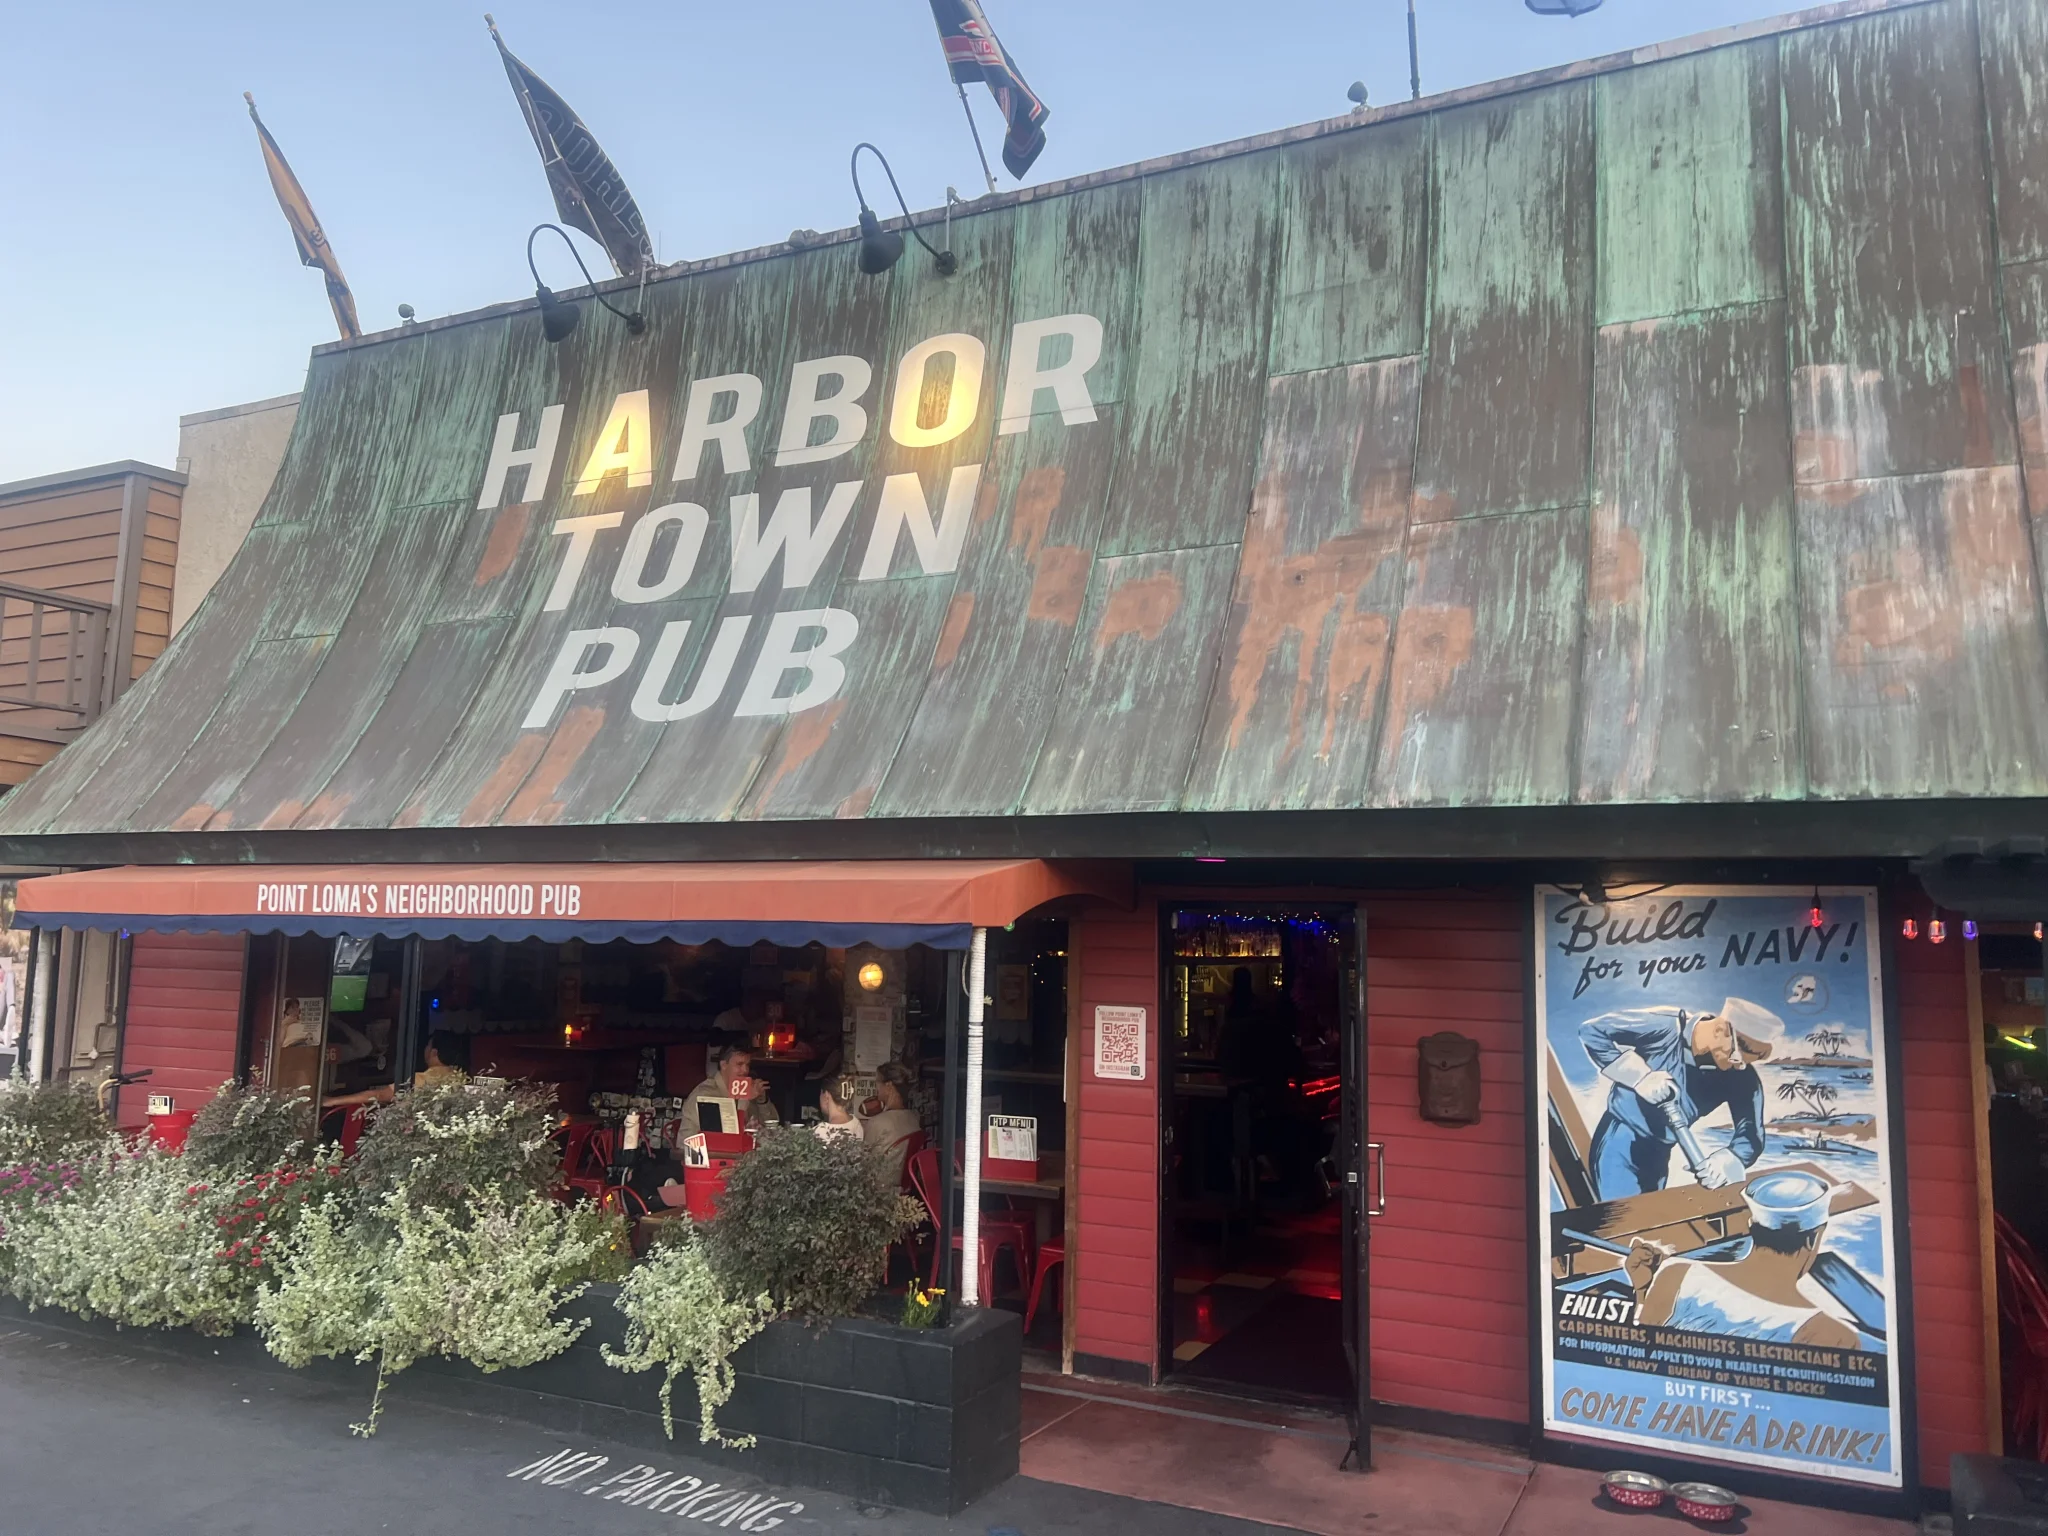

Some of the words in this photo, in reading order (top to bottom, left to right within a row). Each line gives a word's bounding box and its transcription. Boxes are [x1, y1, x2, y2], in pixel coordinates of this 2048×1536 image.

[477, 313, 1103, 509] HARBOR
[543, 463, 981, 612] TOWN
[521, 606, 859, 728] PUB
[257, 884, 308, 912] POINT
[312, 884, 378, 913] LOMA'S
[385, 884, 533, 914] NEIGHBORHOOD
[540, 884, 581, 915] PUB
[1554, 898, 1718, 957] Build
[1572, 955, 1623, 1000] for
[1638, 952, 1707, 988] your
[1719, 921, 1858, 968] NAVY!
[731, 1080, 748, 1095] 82
[857, 1080, 868, 1088] HOT
[857, 1088, 871, 1096] COLD
[993, 1117, 1007, 1128] HTP
[1009, 1118, 1031, 1129] MENU
[1559, 1293, 1644, 1326] ENLIST!
[1558, 1319, 1651, 1345] CARPENTERS,
[1655, 1331, 1741, 1356] MACHINISTS,
[1744, 1342, 1841, 1369] ELECTRICIANS
[1848, 1355, 1878, 1373] ETC.
[1559, 1336, 1578, 1349] FOR
[1580, 1339, 1646, 1358] INFORMATION
[1696, 1356, 1722, 1369] YOUR
[1726, 1359, 1771, 1376] NEAREST
[1604, 1356, 1623, 1368] U.S.
[1627, 1359, 1659, 1372] NAVY
[1668, 1365, 1711, 1381] BUREAU
[1715, 1371, 1729, 1383] OF
[1734, 1374, 1771, 1389] YARDS
[1787, 1380, 1826, 1396] DOCKS
[1665, 1381, 1696, 1399] BUT
[1561, 1386, 1648, 1429] COME
[1648, 1401, 1737, 1442] HAVE
[1733, 1413, 1757, 1447] A
[1763, 1417, 1886, 1464] DRINK!
[506, 1448, 609, 1486] NO
[582, 1464, 804, 1532] PARKING
